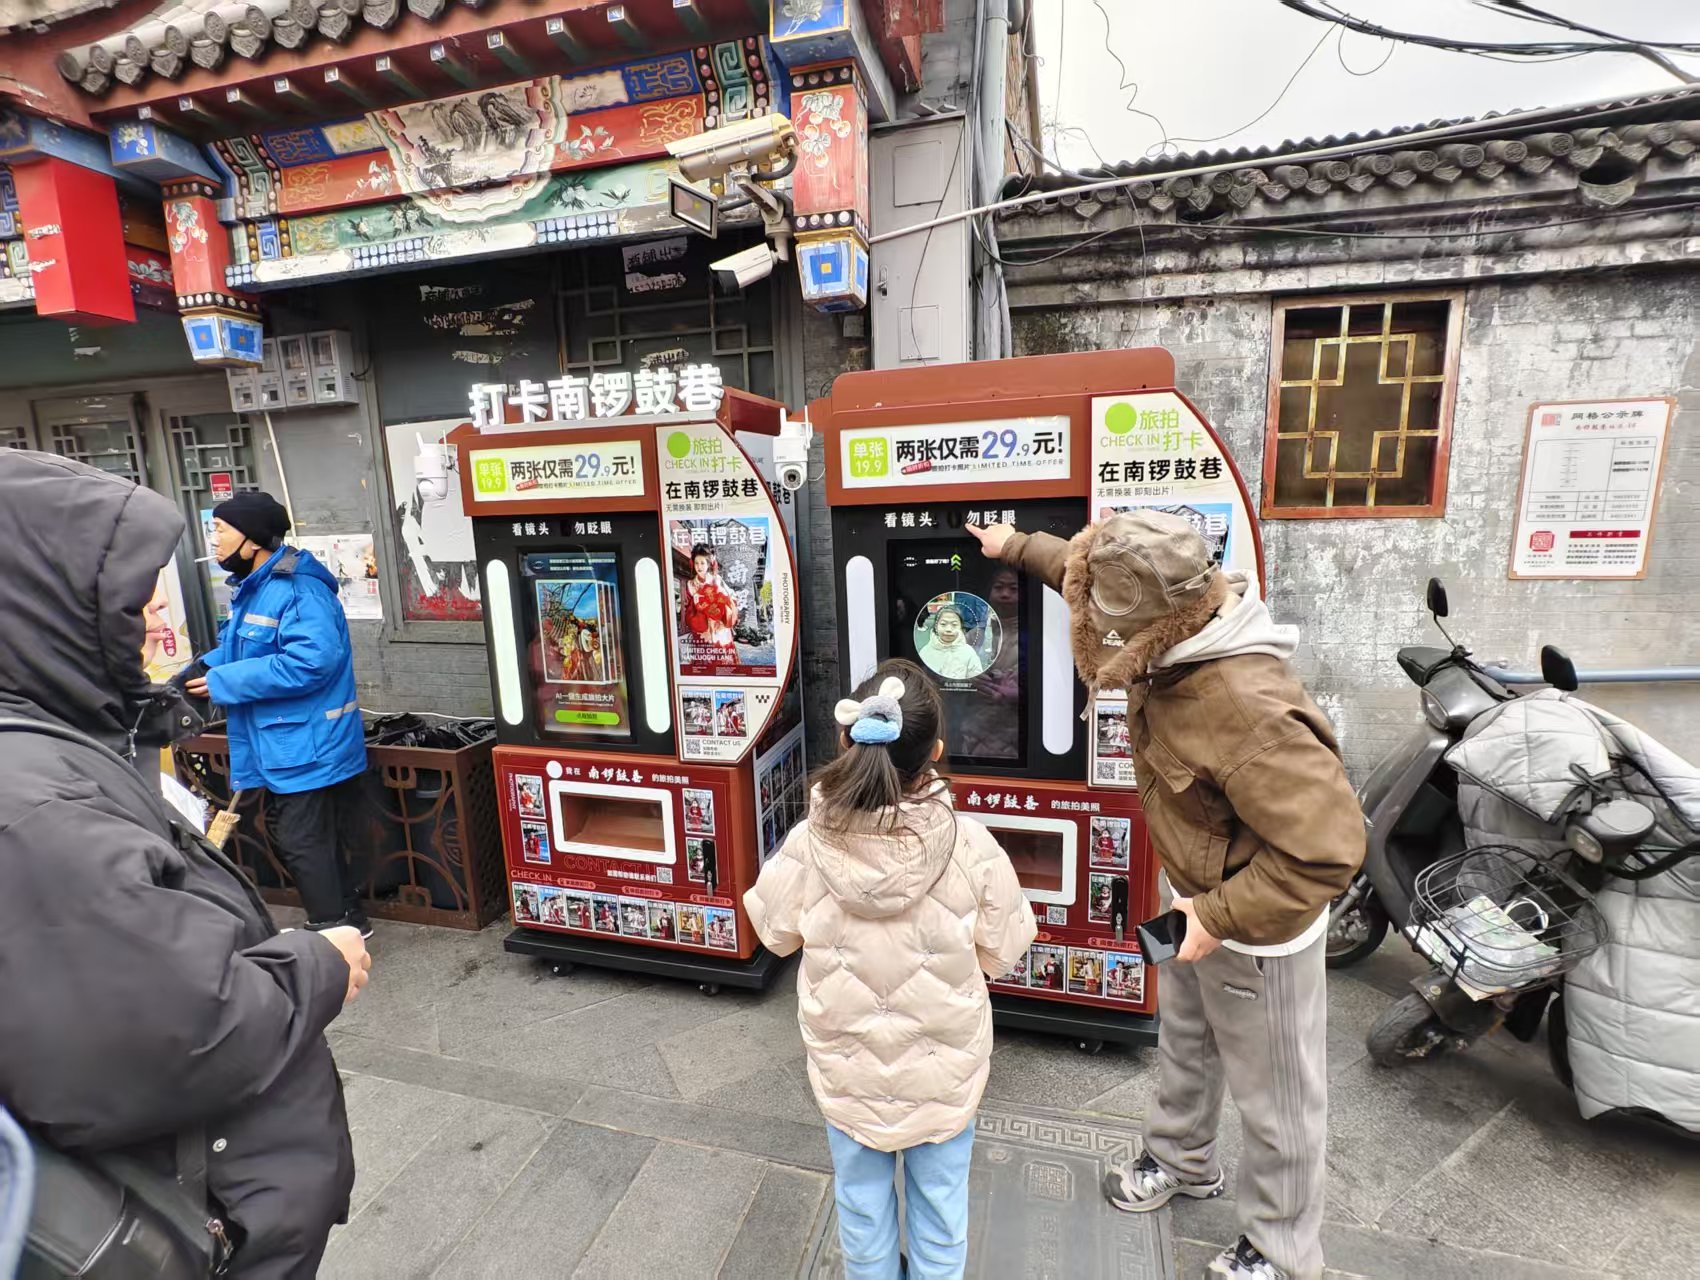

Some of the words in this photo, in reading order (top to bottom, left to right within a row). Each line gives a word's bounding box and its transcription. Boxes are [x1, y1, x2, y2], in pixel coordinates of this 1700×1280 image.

[468, 363, 724, 428] 打卡南锣鼓巷
[1139, 408, 1179, 430] 旅拍
[693, 437, 722, 455] 旅拍
[853, 441, 884, 457] 单张
[1100, 433, 1141, 448] CHECK
[1147, 433, 1160, 446] IN
[1162, 431, 1203, 452] 打卡
[478, 462, 503, 475] 单张
[665, 459, 697, 469] CHECK
[700, 458, 710, 468] IN
[711, 456, 743, 473] 打卡
[855, 459, 882, 473] 19.9
[1098, 456, 1223, 484] 在南锣鼓巷
[665, 478, 758, 500] 在南锣鼓巷
[884, 512, 933, 528] 看镜头
[966, 509, 1016, 526] 勿眨眼
[512, 522, 549, 536] 看镜头
[575, 521, 612, 535] 勿眨眼
[672, 526, 767, 548] 在南锣鼓巷
[782, 572, 790, 624] PHOTOGRAPHY
[1102, 638, 1125, 647] PEAK
[967, 791, 1039, 810] 南锣鼓巷
[1051, 800, 1100, 812] 的旅拍美照
[510, 869, 540, 880] CHECK
